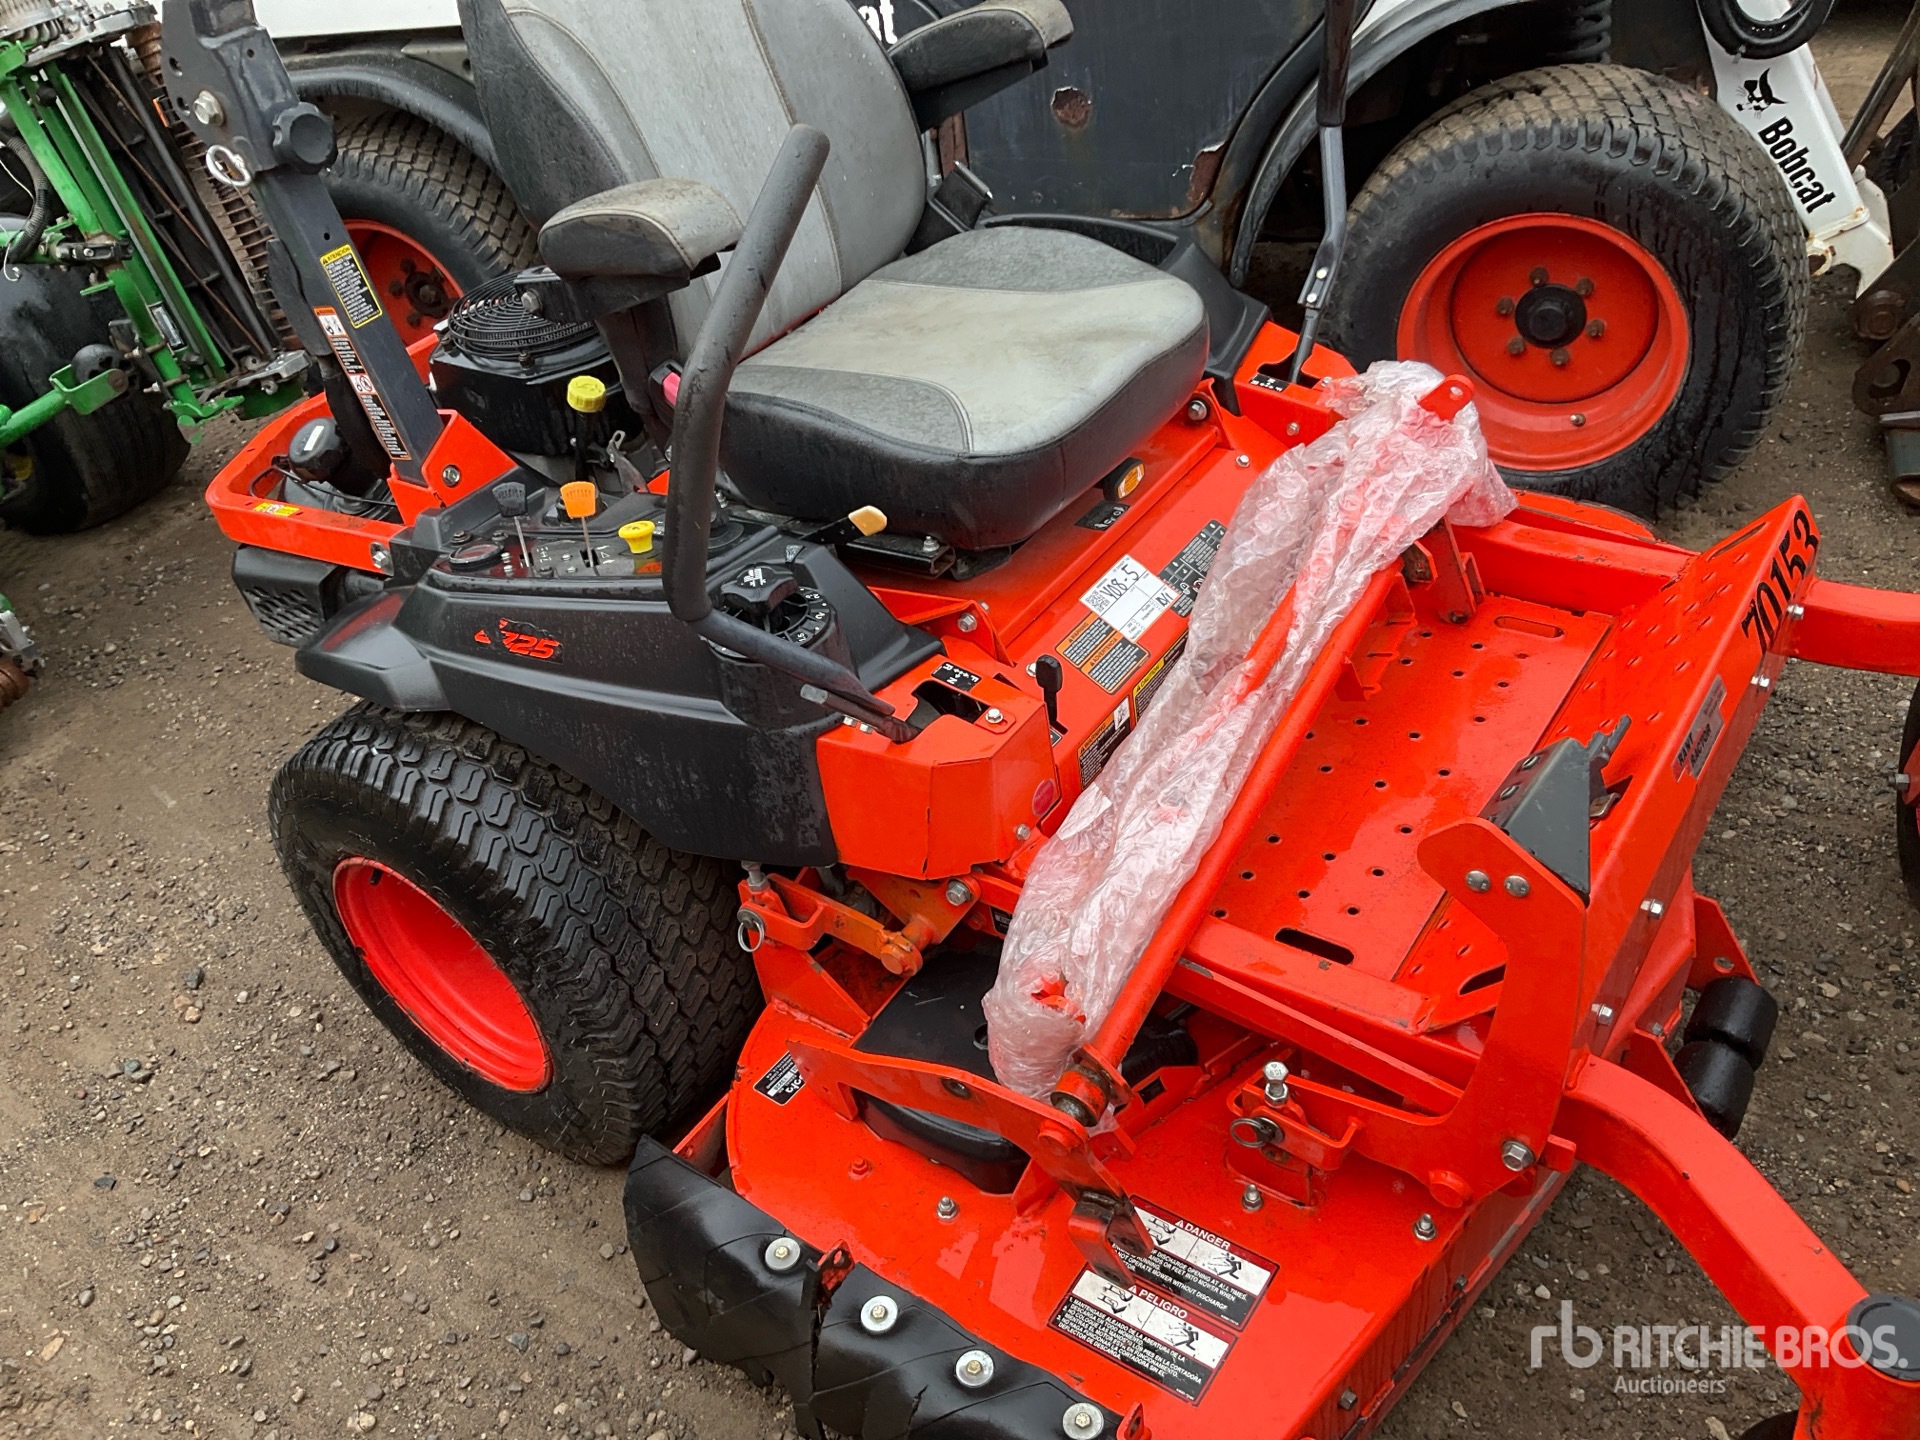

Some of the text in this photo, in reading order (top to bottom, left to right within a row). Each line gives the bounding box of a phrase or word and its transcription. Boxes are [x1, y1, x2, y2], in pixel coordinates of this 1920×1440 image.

[1758, 116, 1836, 214] Bobcat
[1741, 509, 1819, 656] 70153
[942, 663, 954, 671] R
[1093, 637, 1118, 662] ADVERTENCIA
[946, 676, 958, 685] N
[1183, 1222, 1231, 1250] DANGER
[1116, 1251, 1128, 1260] NOT
[1127, 1257, 1152, 1272] OPERATE
[1151, 1269, 1172, 1282] MOWER
[1171, 1279, 1196, 1294] WITHOUT
[1195, 1291, 1228, 1310] DISCHARGE
[1147, 1254, 1236, 1301] ANDS OR FEET INTO MOWER WHEN
[1156, 1251, 1187, 1270] DISCHARGE
[1186, 1266, 1211, 1282] OPENING
[1210, 1278, 1219, 1286] AT
[1218, 1282, 1230, 1291] ALL
[1069, 1303, 1097, 1320] DESCARGA
[1103, 1321, 1118, 1332] TODO
[1117, 1328, 1145, 1346] MOMENTO.
[1137, 1288, 1189, 1319] PELIGRO
[1057, 1322, 1086, 1340] DEFLECTOR
[1085, 1336, 1094, 1344] DE
[1063, 1312, 1089, 1328] MIENTRAS
[1094, 1329, 1113, 1342] MOTOR
[1133, 1350, 1179, 1377] FUNCIONAMIENTO.
[1068, 1321, 1083, 1332] HAGA
[1082, 1329, 1111, 1347] FUNCIONAR
[1117, 1348, 1150, 1368] CORTADORA
[1148, 1364, 1159, 1372] SIN
[1157, 1369, 1166, 1377] EL
[1072, 1299, 1106, 1319] MANTENGASE
[1105, 1316, 1128, 1331] ALEJADO
[1142, 1336, 1170, 1353] ABERTURA
[1177, 1354, 1186, 1362] LA
[1074, 1312, 1099, 1327] COLOQUE
[1097, 1324, 1109, 1333] LAS
[1108, 1330, 1126, 1342] MANOS
[1132, 1342, 1143, 1351] LOS
[1142, 1348, 1155, 1358] PIES
[1168, 1362, 1203, 1384] CORTADORA
